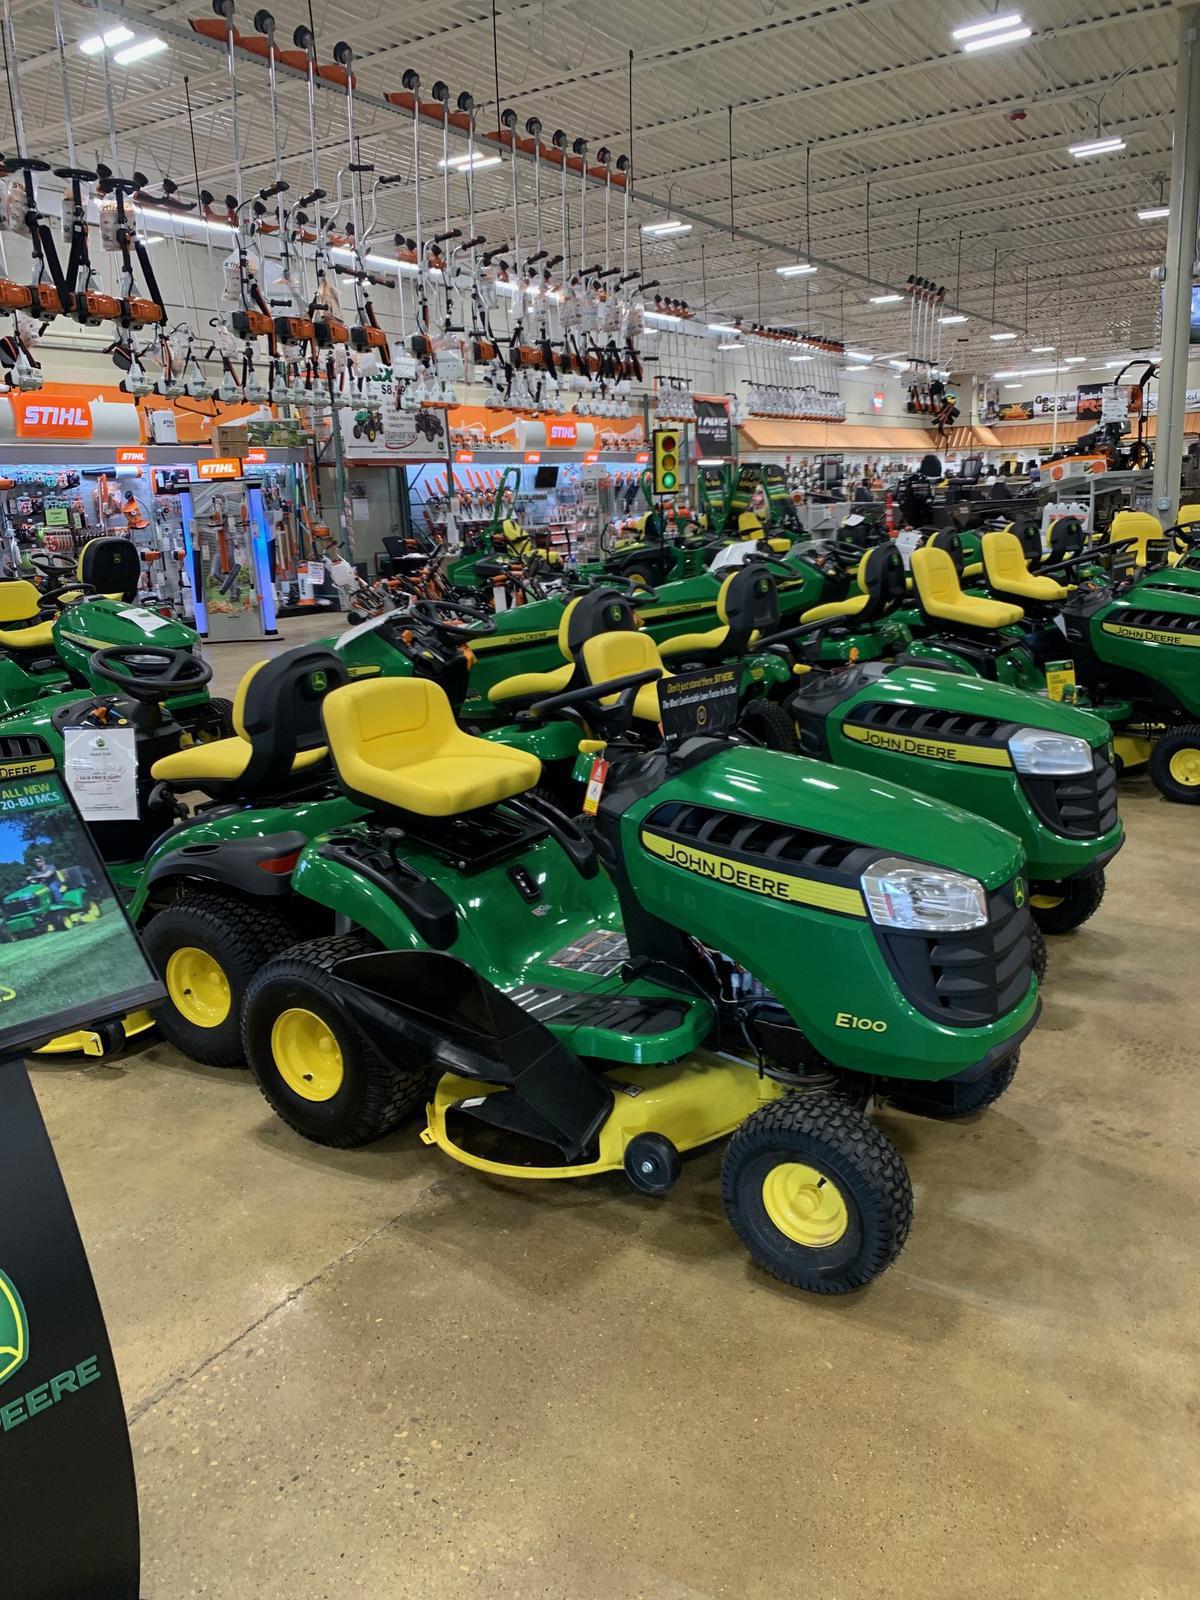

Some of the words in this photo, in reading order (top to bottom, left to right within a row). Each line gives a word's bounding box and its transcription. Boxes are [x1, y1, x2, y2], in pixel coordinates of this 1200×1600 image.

[1035, 394, 1076, 406] Georgia
[1042, 404, 1067, 412] Boot
[24, 406, 88, 425] STIHL
[551, 426, 576, 438] STIHL
[121, 453, 146, 461] STIHL
[201, 463, 236, 475] STIHL
[1116, 627, 1144, 639] JOHN
[1145, 632, 1182, 644] DEERE
[862, 730, 901, 749] JOHN
[904, 740, 957, 760] DEERE
[2, 788, 24, 799] ALL
[24, 783, 50, 795] NEW
[1, 797, 35, 810] 20-BU
[35, 792, 60, 803] MCS
[665, 844, 716, 876] JOHN
[719, 862, 790, 897] DEERE
[835, 1012, 887, 1033] E100
[0, 1355, 101, 1432] EERE
